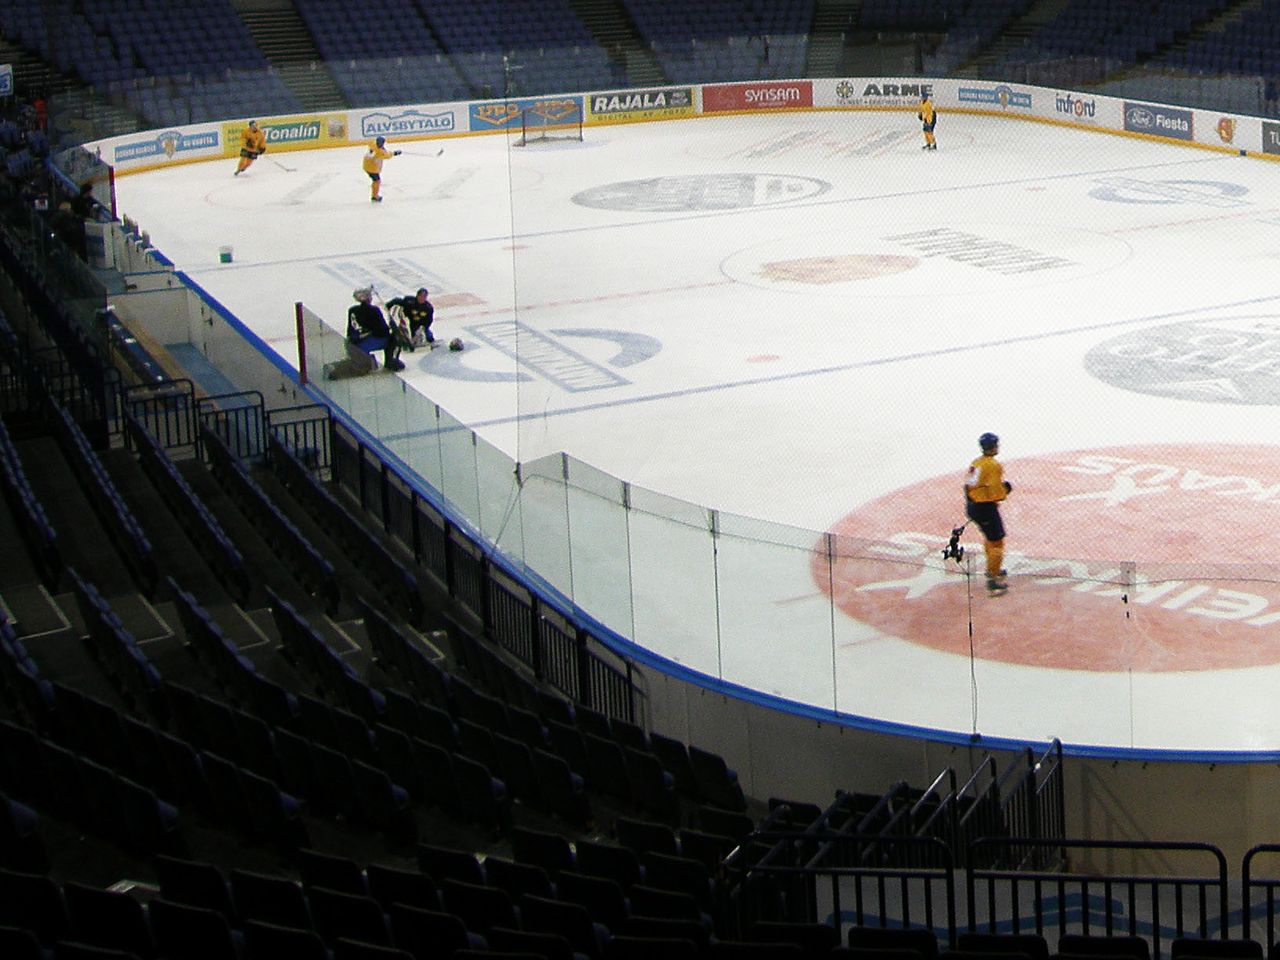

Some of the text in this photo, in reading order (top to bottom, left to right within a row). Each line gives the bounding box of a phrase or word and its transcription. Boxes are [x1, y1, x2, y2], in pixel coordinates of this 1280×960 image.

[863, 83, 933, 96] ARME
[594, 92, 666, 111] RAJALA
[1056, 93, 1095, 117] infront
[262, 123, 318, 142] Tonalin
[1156, 114, 1188, 132] Fiesta
